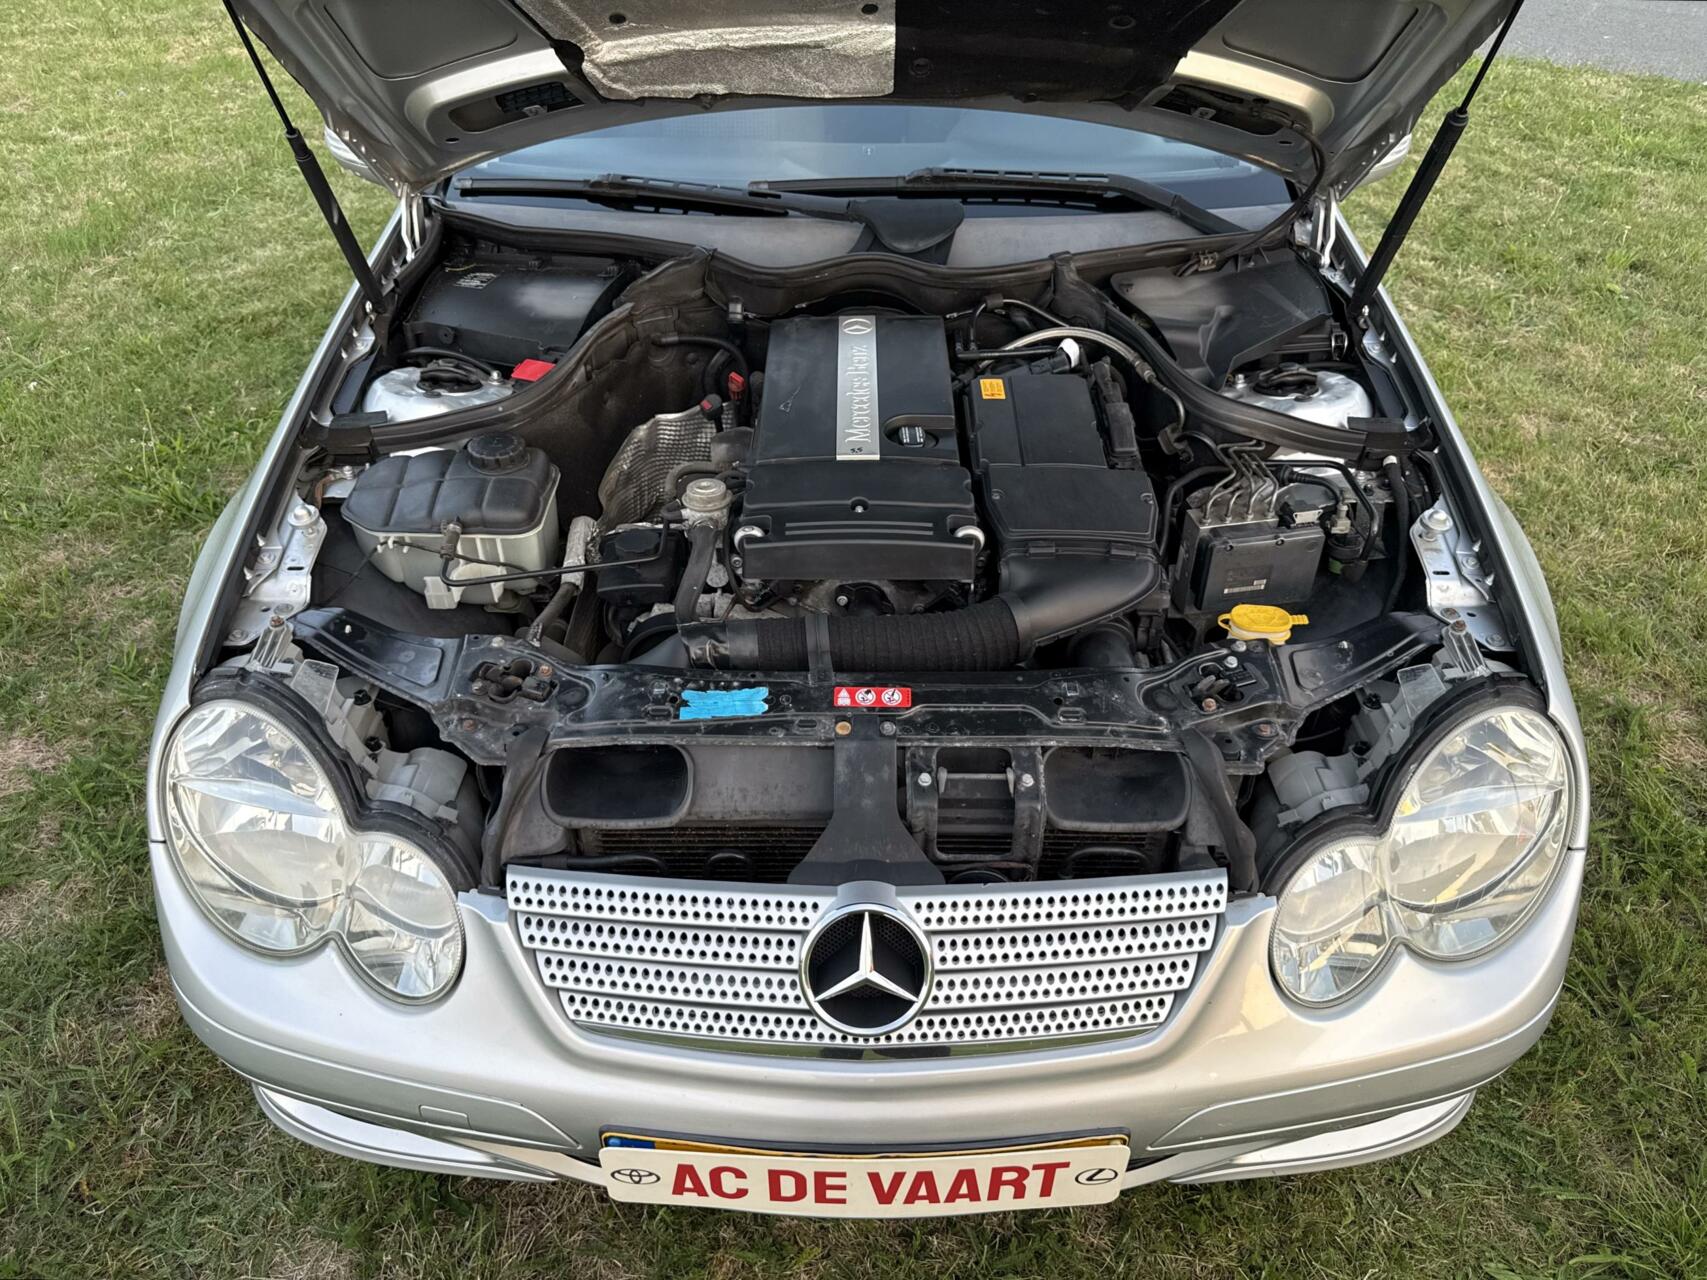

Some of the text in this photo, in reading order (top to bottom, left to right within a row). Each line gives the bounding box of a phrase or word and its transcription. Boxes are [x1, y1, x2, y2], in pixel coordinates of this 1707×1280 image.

[672, 1161, 1071, 1206] AC DE VAART
